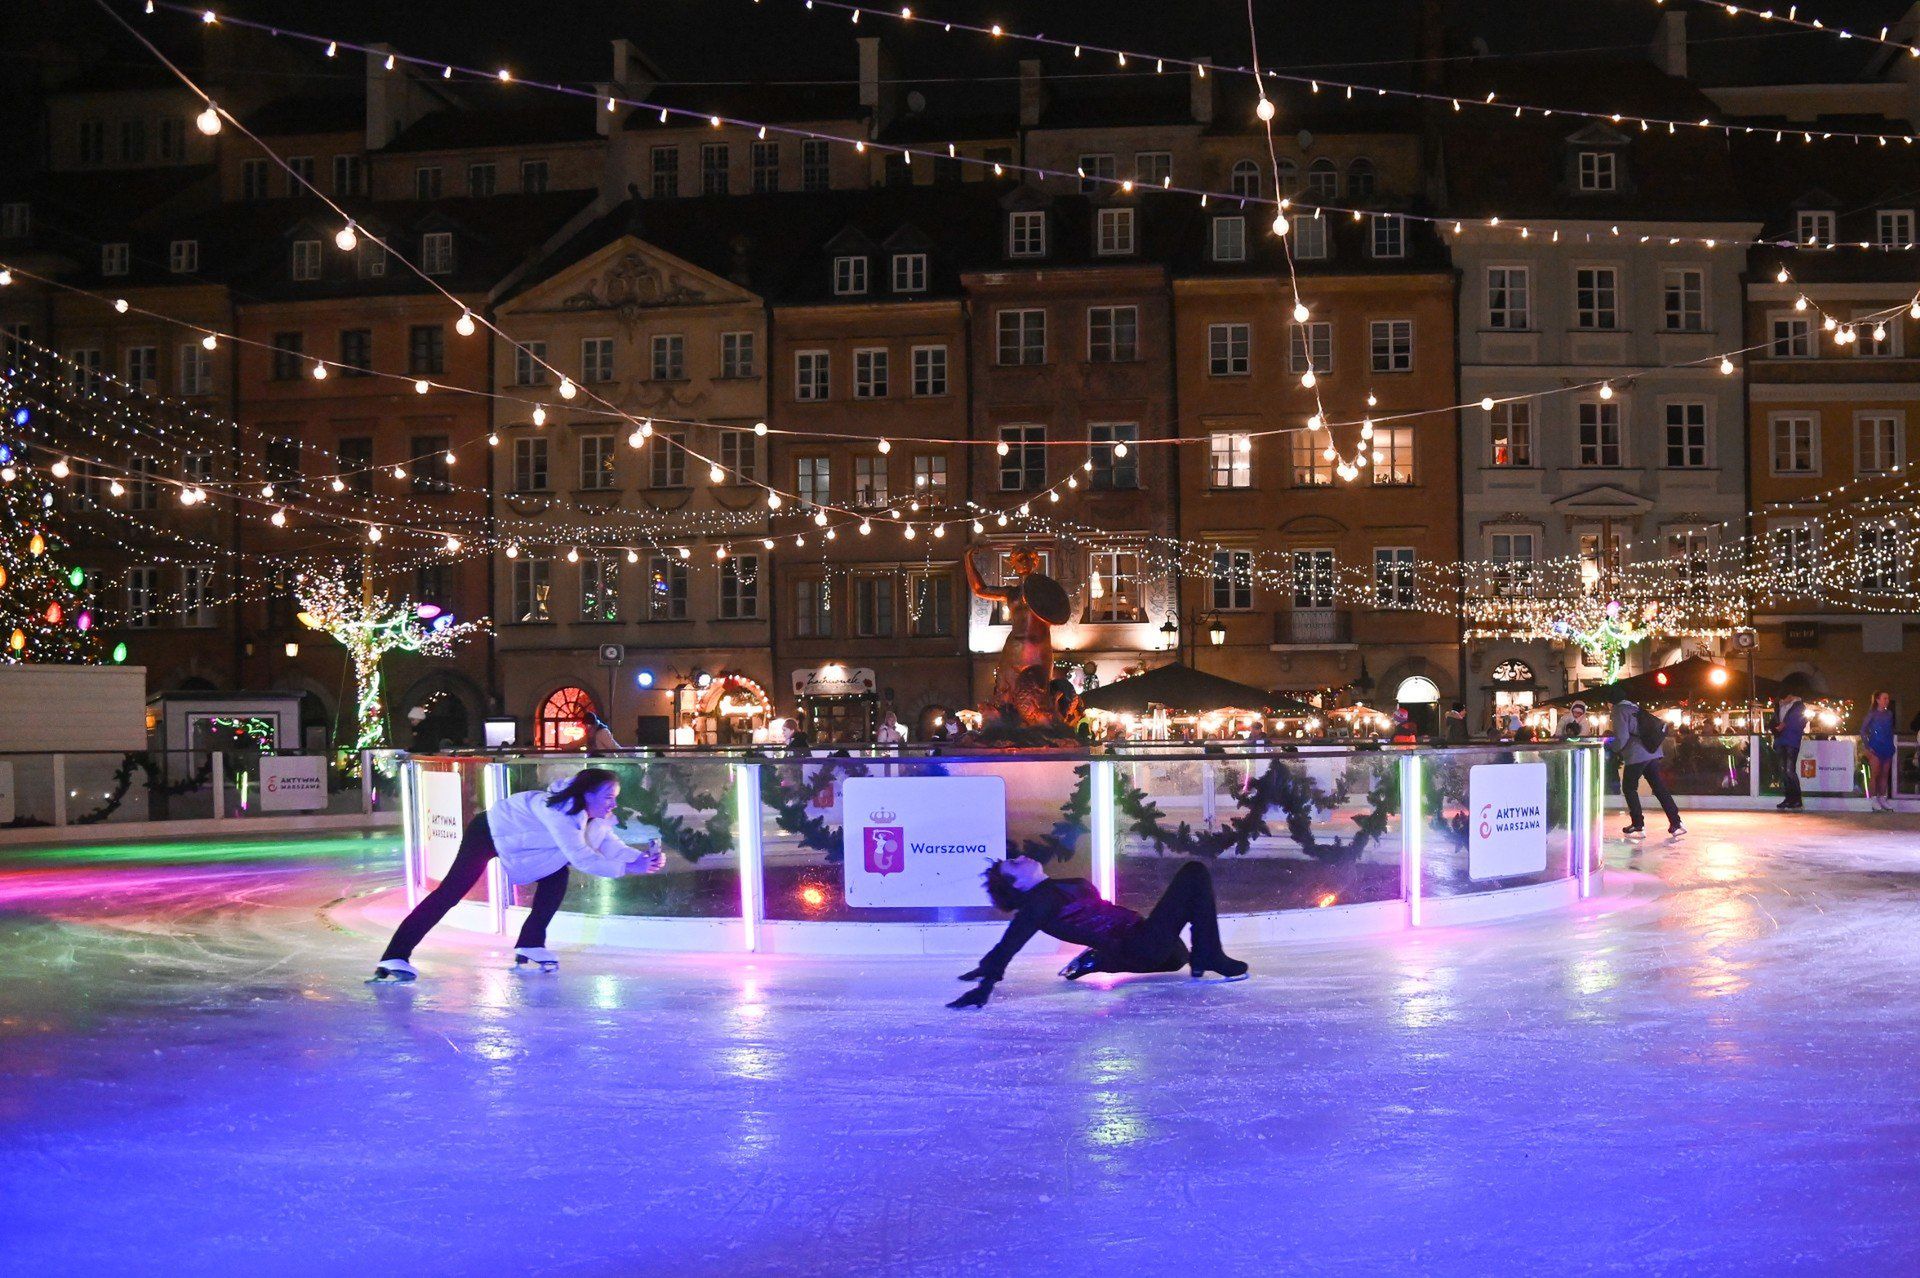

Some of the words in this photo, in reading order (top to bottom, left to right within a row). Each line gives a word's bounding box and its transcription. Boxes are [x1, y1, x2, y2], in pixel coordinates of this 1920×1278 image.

[1496, 806, 1541, 819] AKTYWNA
[432, 814, 457, 826] AKTYWNA
[1496, 821, 1541, 832] WARSZAWA
[432, 829, 457, 839] WARSZAWA
[910, 843, 986, 854] Warszawa
